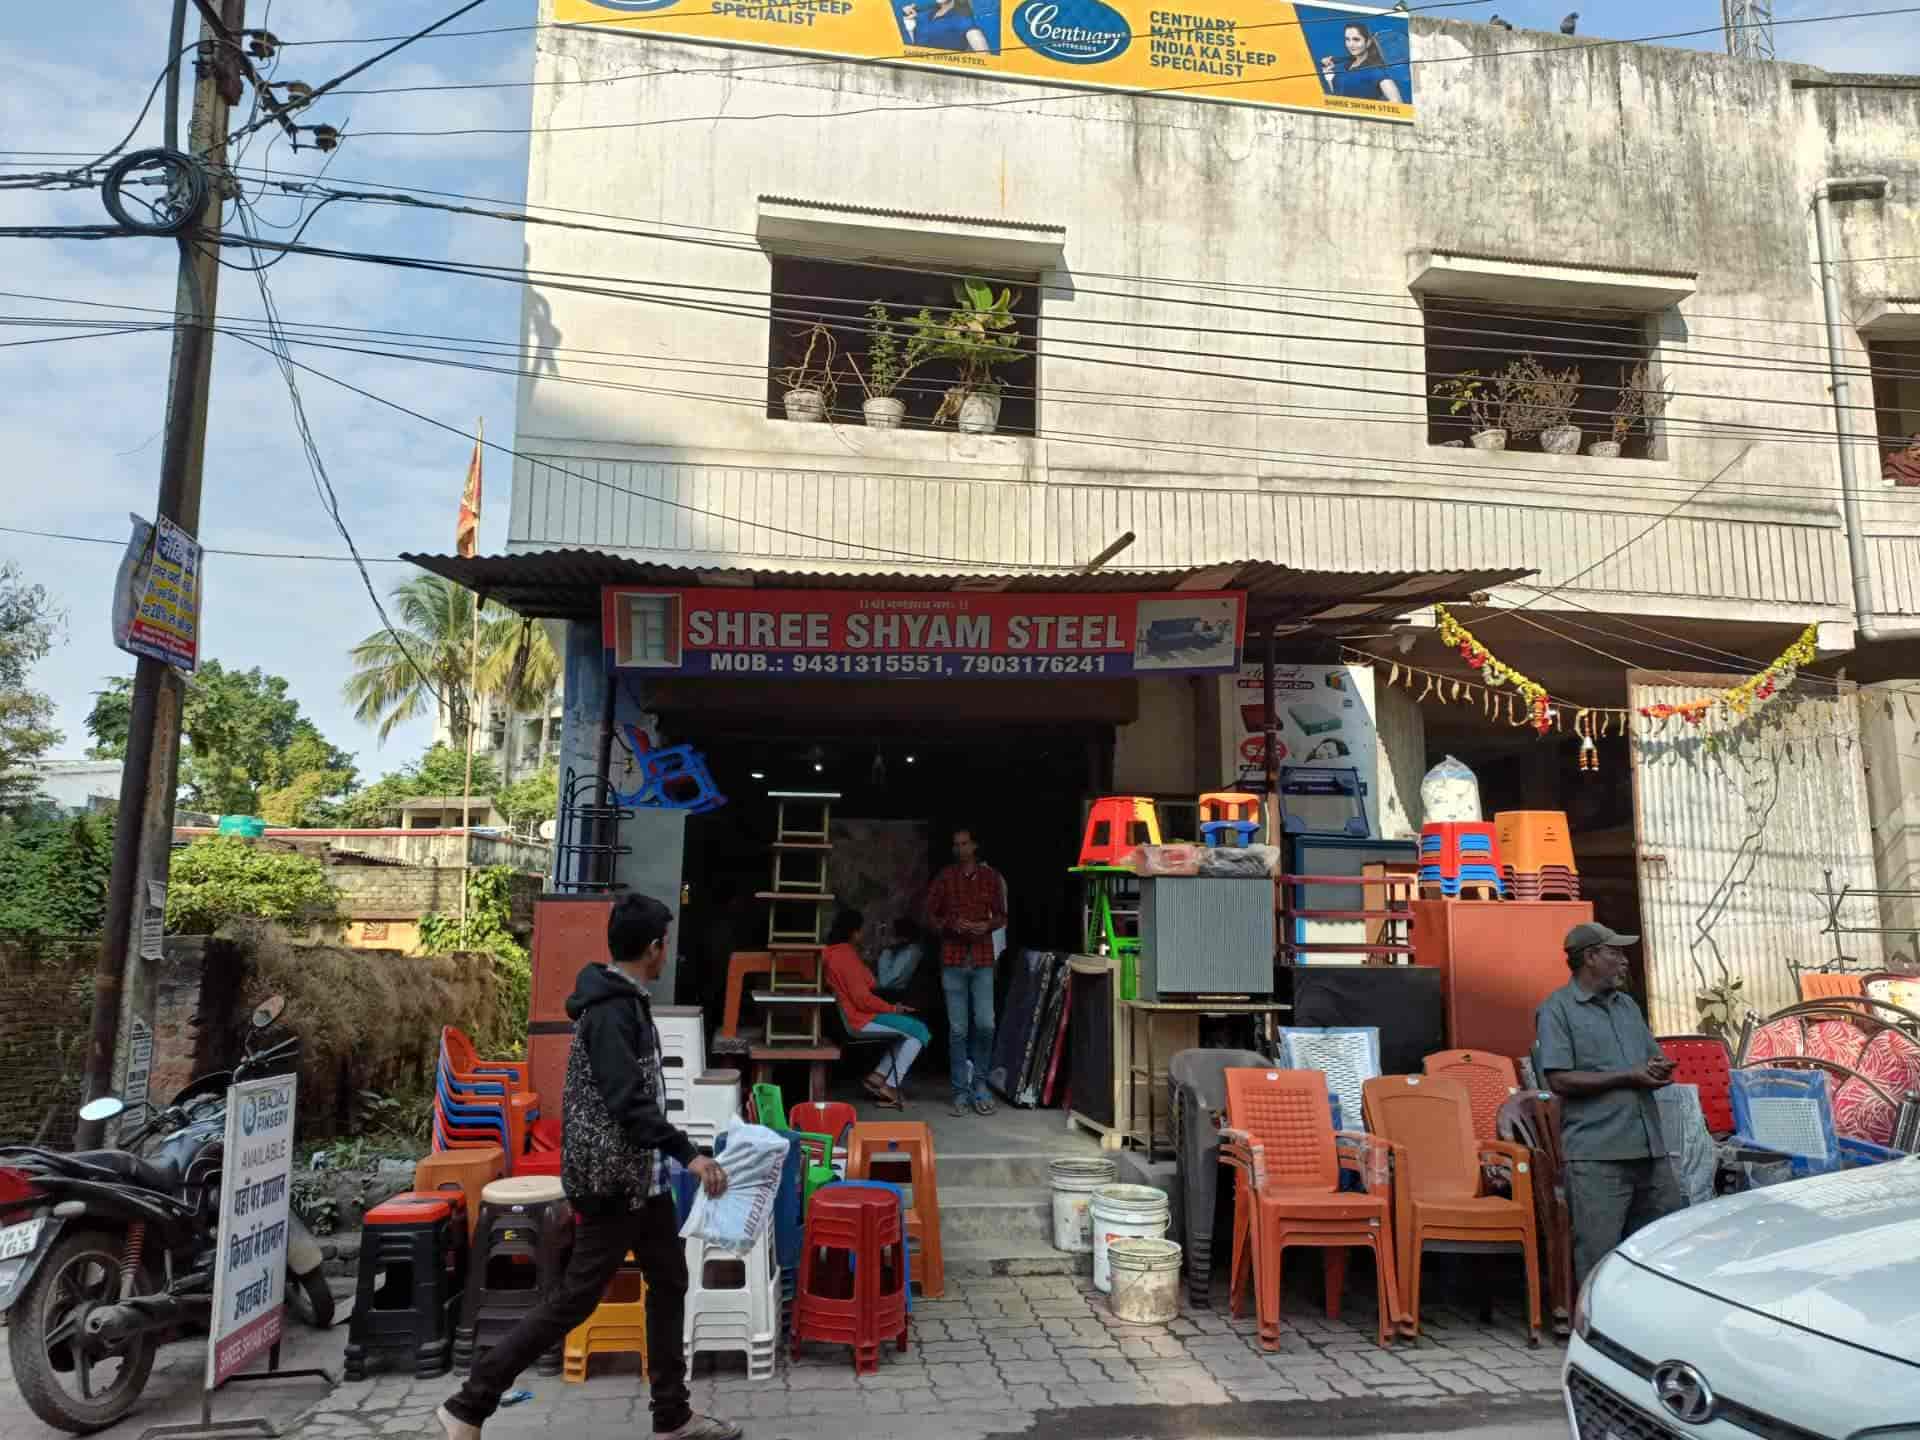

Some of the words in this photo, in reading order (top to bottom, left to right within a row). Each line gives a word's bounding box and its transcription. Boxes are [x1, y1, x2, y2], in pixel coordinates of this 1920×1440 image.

[711, 1, 816, 26] SPECIALIST
[1150, 11, 1237, 32] CENTUARY
[1150, 25, 1235, 47] MATTRESS
[1150, 40, 1195, 56] INDIA
[1200, 46, 1222, 60] KA
[1226, 49, 1277, 66] SLEEP
[1150, 54, 1244, 77] SPECIALIST
[687, 610, 831, 648] SHREE
[846, 613, 992, 649] SHYAM
[1007, 615, 1126, 649] STEEL
[710, 653, 784, 672] MOB.:
[792, 654, 953, 676] 9431315551,
[960, 655, 1105, 674] 7903176241
[257, 1108, 289, 1132] FINSERV
[240, 1138, 287, 1169] AVAILABLE
